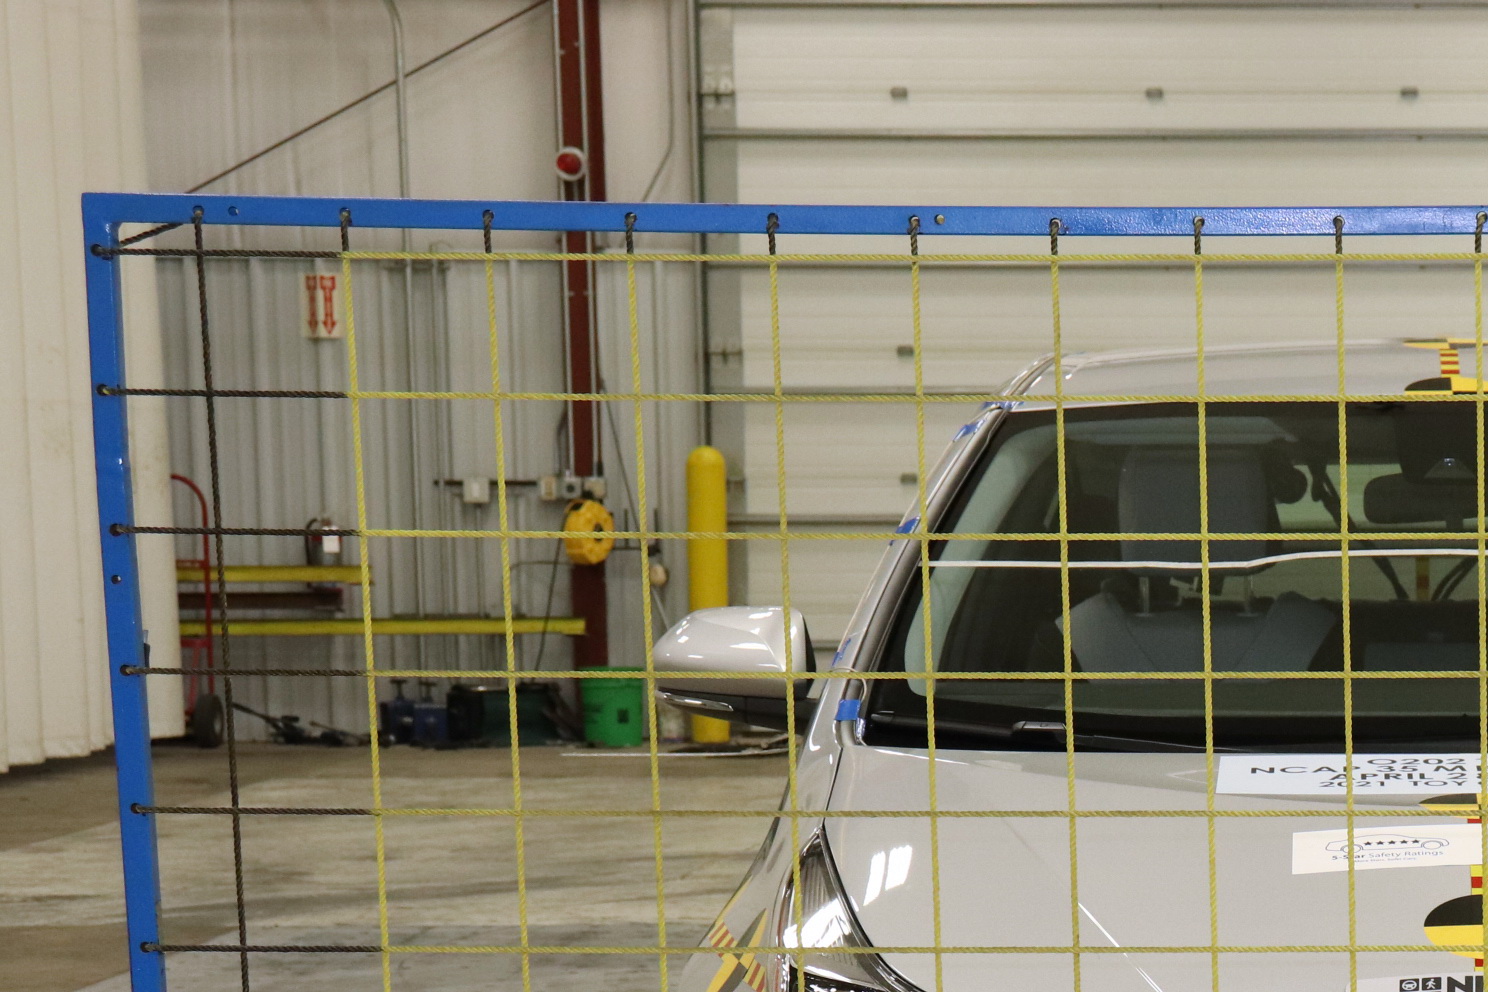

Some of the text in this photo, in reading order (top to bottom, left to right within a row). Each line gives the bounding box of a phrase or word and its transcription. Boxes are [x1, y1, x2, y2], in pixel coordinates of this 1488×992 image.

[1250, 766, 1361, 774] NCAP
[1376, 765, 1419, 773] 35
[1329, 773, 1434, 781] APRIL
